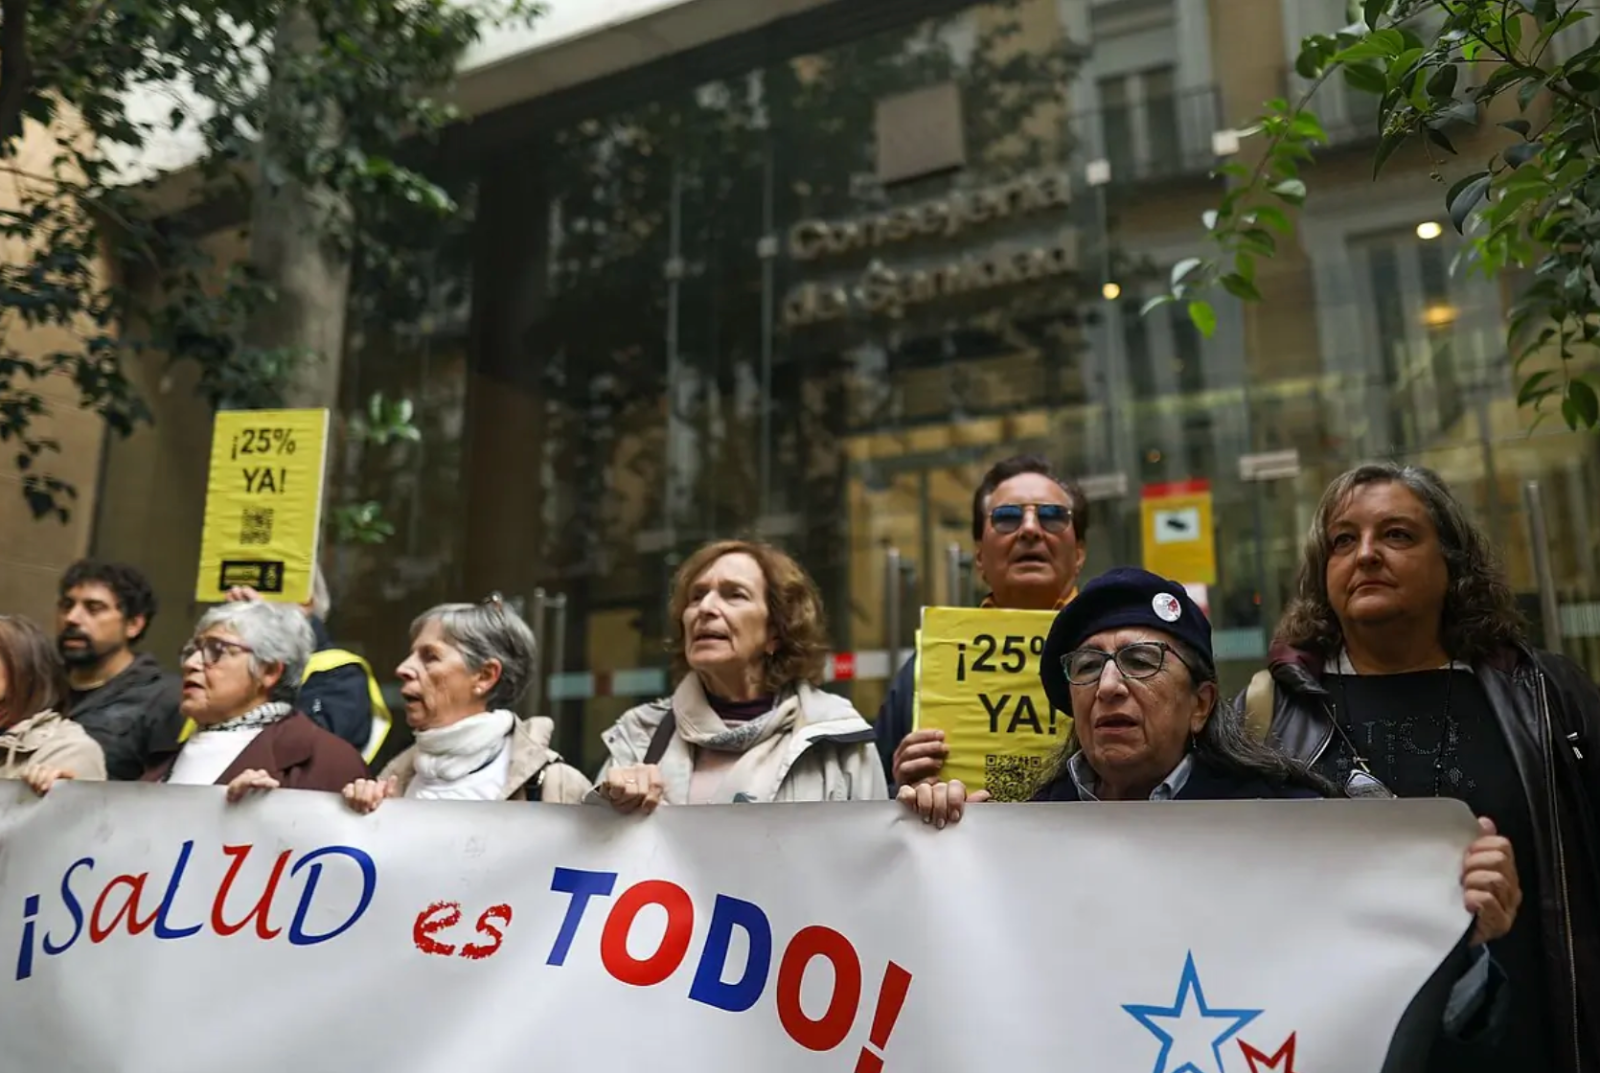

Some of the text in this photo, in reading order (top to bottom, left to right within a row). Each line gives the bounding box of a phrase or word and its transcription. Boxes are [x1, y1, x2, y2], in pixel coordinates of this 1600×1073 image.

[231, 428, 296, 461] ¡25%
[243, 468, 286, 494] YA!
[977, 693, 1057, 735] YA!
[413, 901, 513, 961] es
[545, 866, 913, 1073] TODO!
